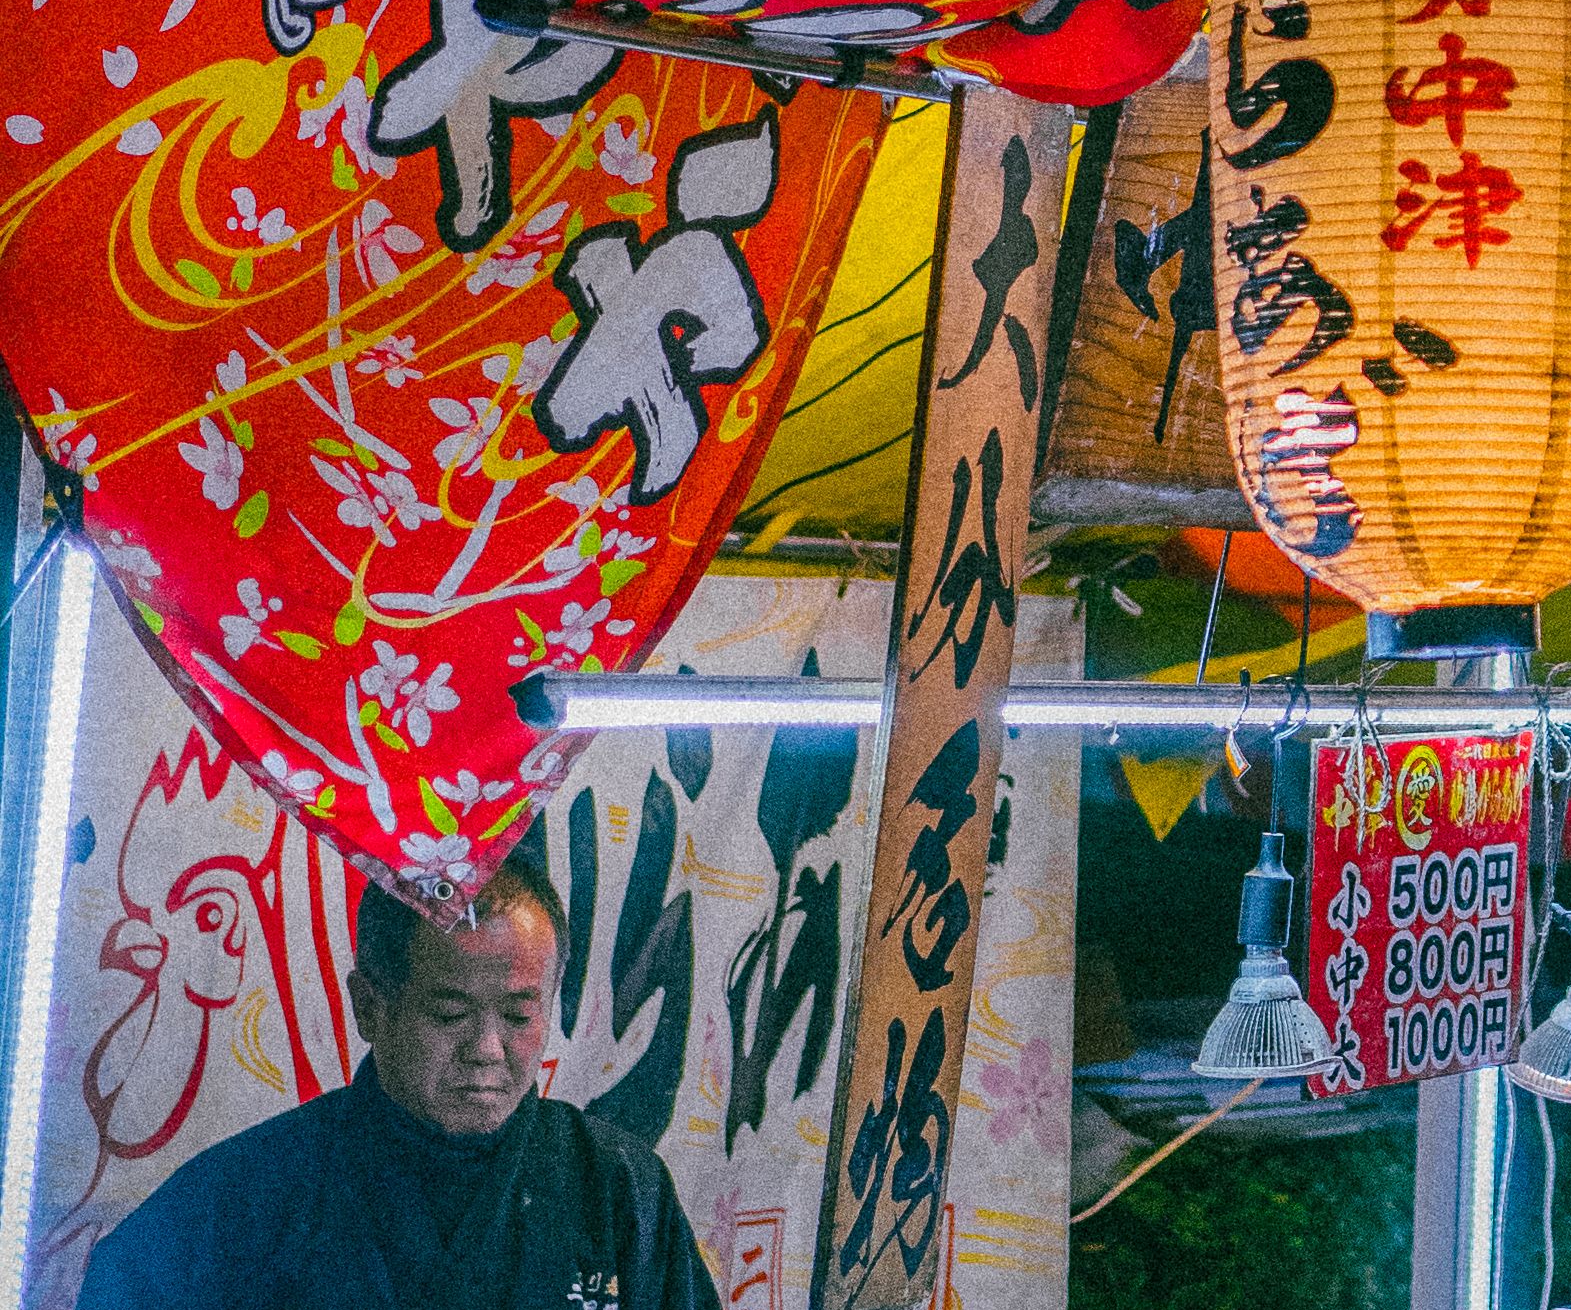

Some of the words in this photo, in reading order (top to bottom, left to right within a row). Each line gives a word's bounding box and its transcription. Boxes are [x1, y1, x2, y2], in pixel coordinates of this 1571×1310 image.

[1328, 861, 1372, 939] 小
[1386, 843, 1518, 929] 500円
[1326, 937, 1369, 1017] 中
[1384, 915, 1514, 1007] 800円
[1322, 1019, 1366, 1093] 大
[1384, 991, 1512, 1079] 1000円
